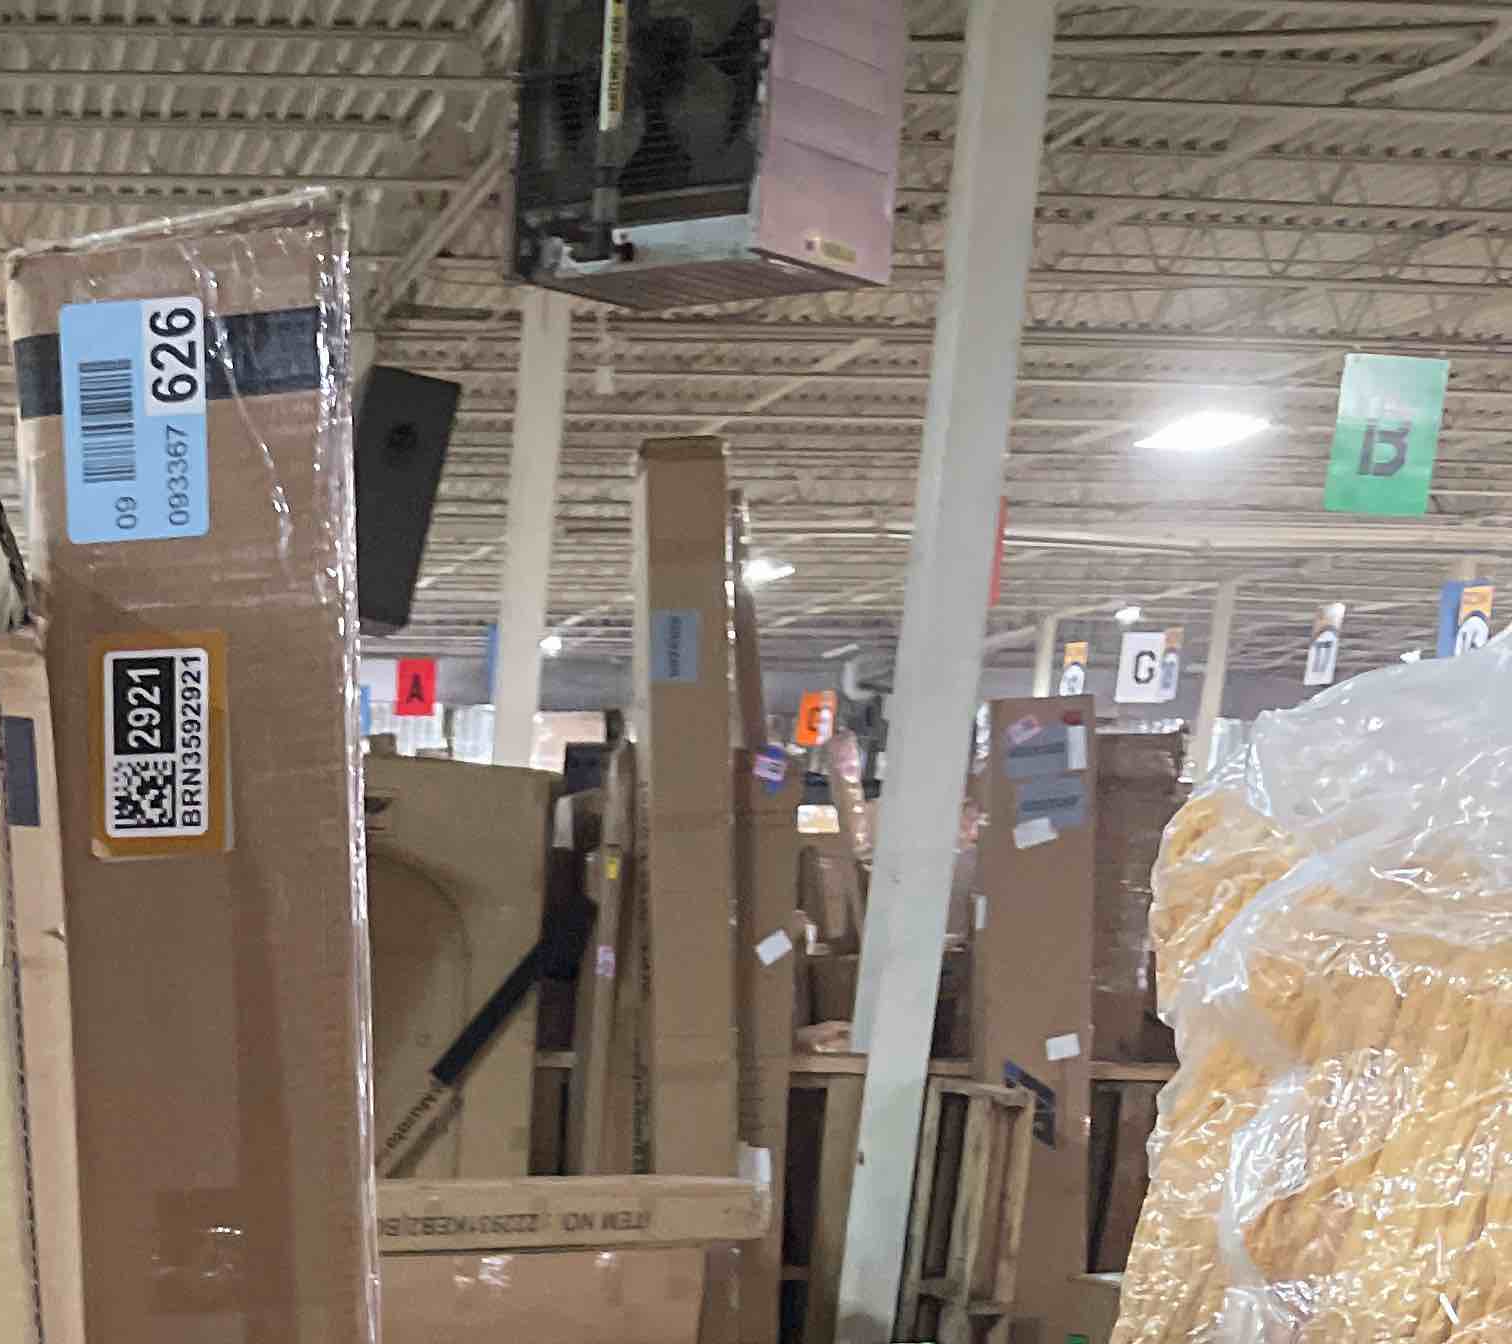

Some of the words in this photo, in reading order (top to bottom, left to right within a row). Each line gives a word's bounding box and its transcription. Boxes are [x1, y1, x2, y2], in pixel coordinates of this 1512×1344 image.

[151, 306, 199, 405] 626
[168, 424, 190, 527] 093367
[1357, 415, 1413, 477] B
[115, 496, 138, 530] 09
[406, 674, 425, 702] A
[1134, 650, 1156, 684] G
[128, 665, 161, 748] 2921
[181, 655, 202, 829] BRN3592921
